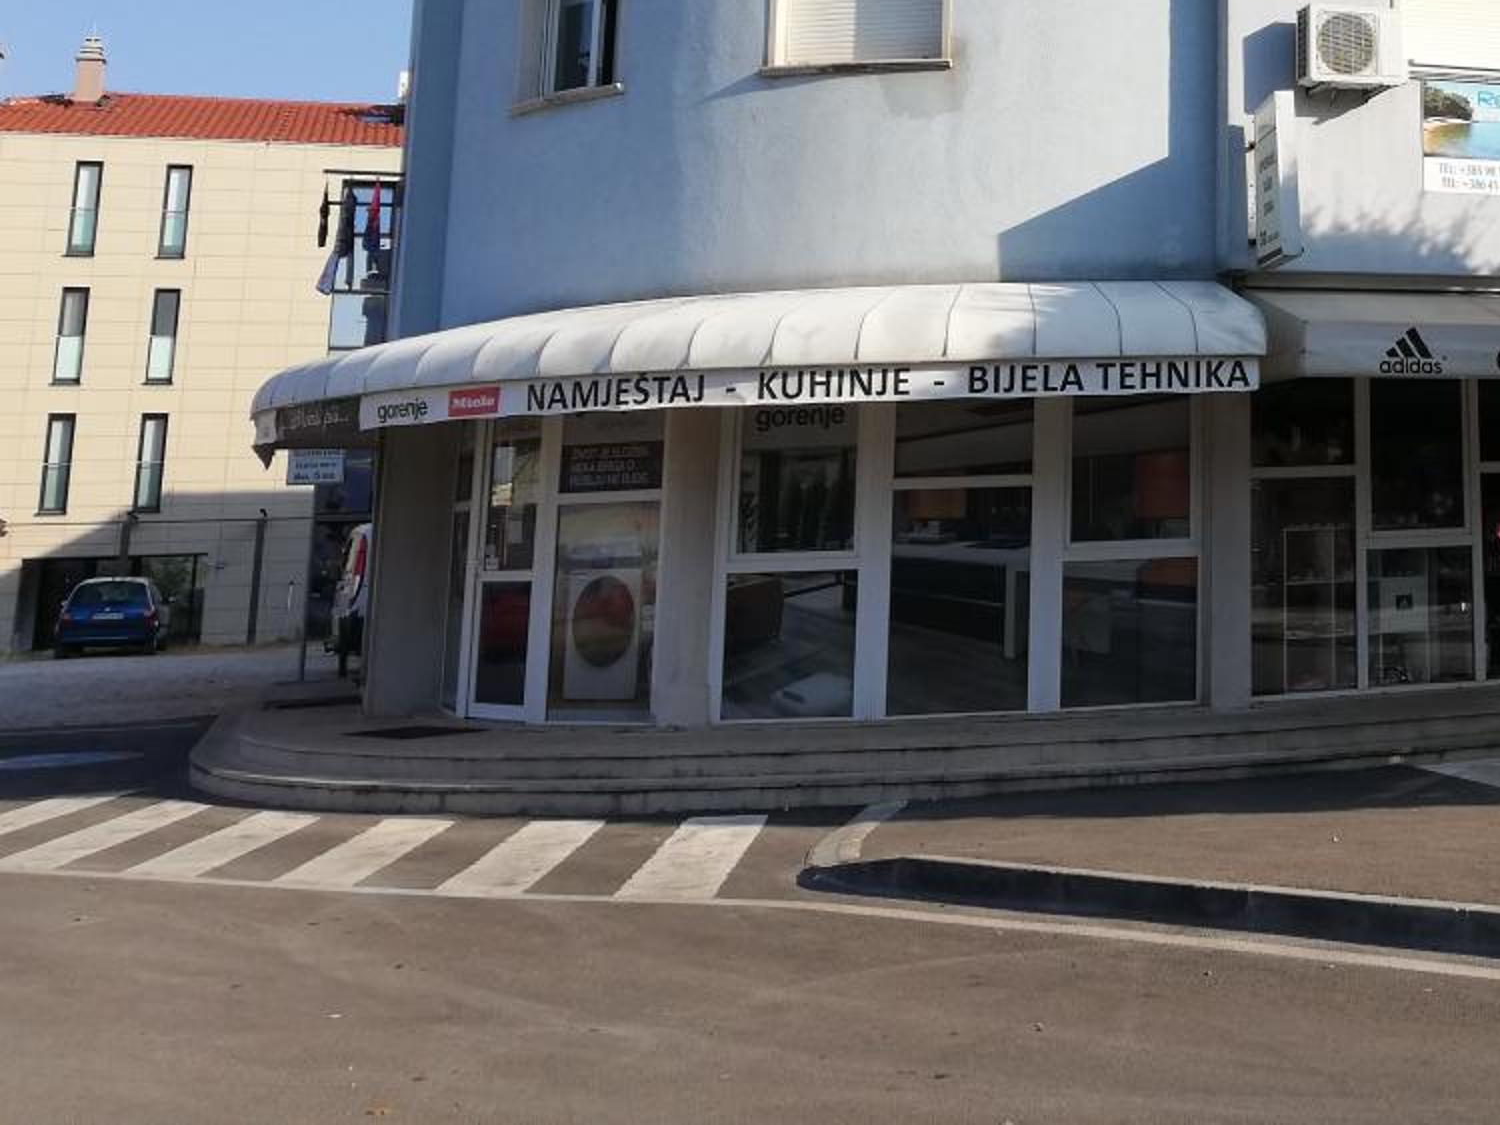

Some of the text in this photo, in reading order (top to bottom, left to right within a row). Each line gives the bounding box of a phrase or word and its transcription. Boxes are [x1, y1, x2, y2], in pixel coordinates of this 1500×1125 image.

[1379, 357, 1443, 374] adidas
[526, 372, 705, 412] NAMJEŠTAJ
[757, 367, 911, 401] KUHINJE
[967, 364, 1085, 394] BIJELA
[1096, 360, 1251, 391] TEHNIKA
[377, 398, 428, 423] gorenje
[451, 394, 496, 409] Miele
[756, 404, 846, 431] gorenje
